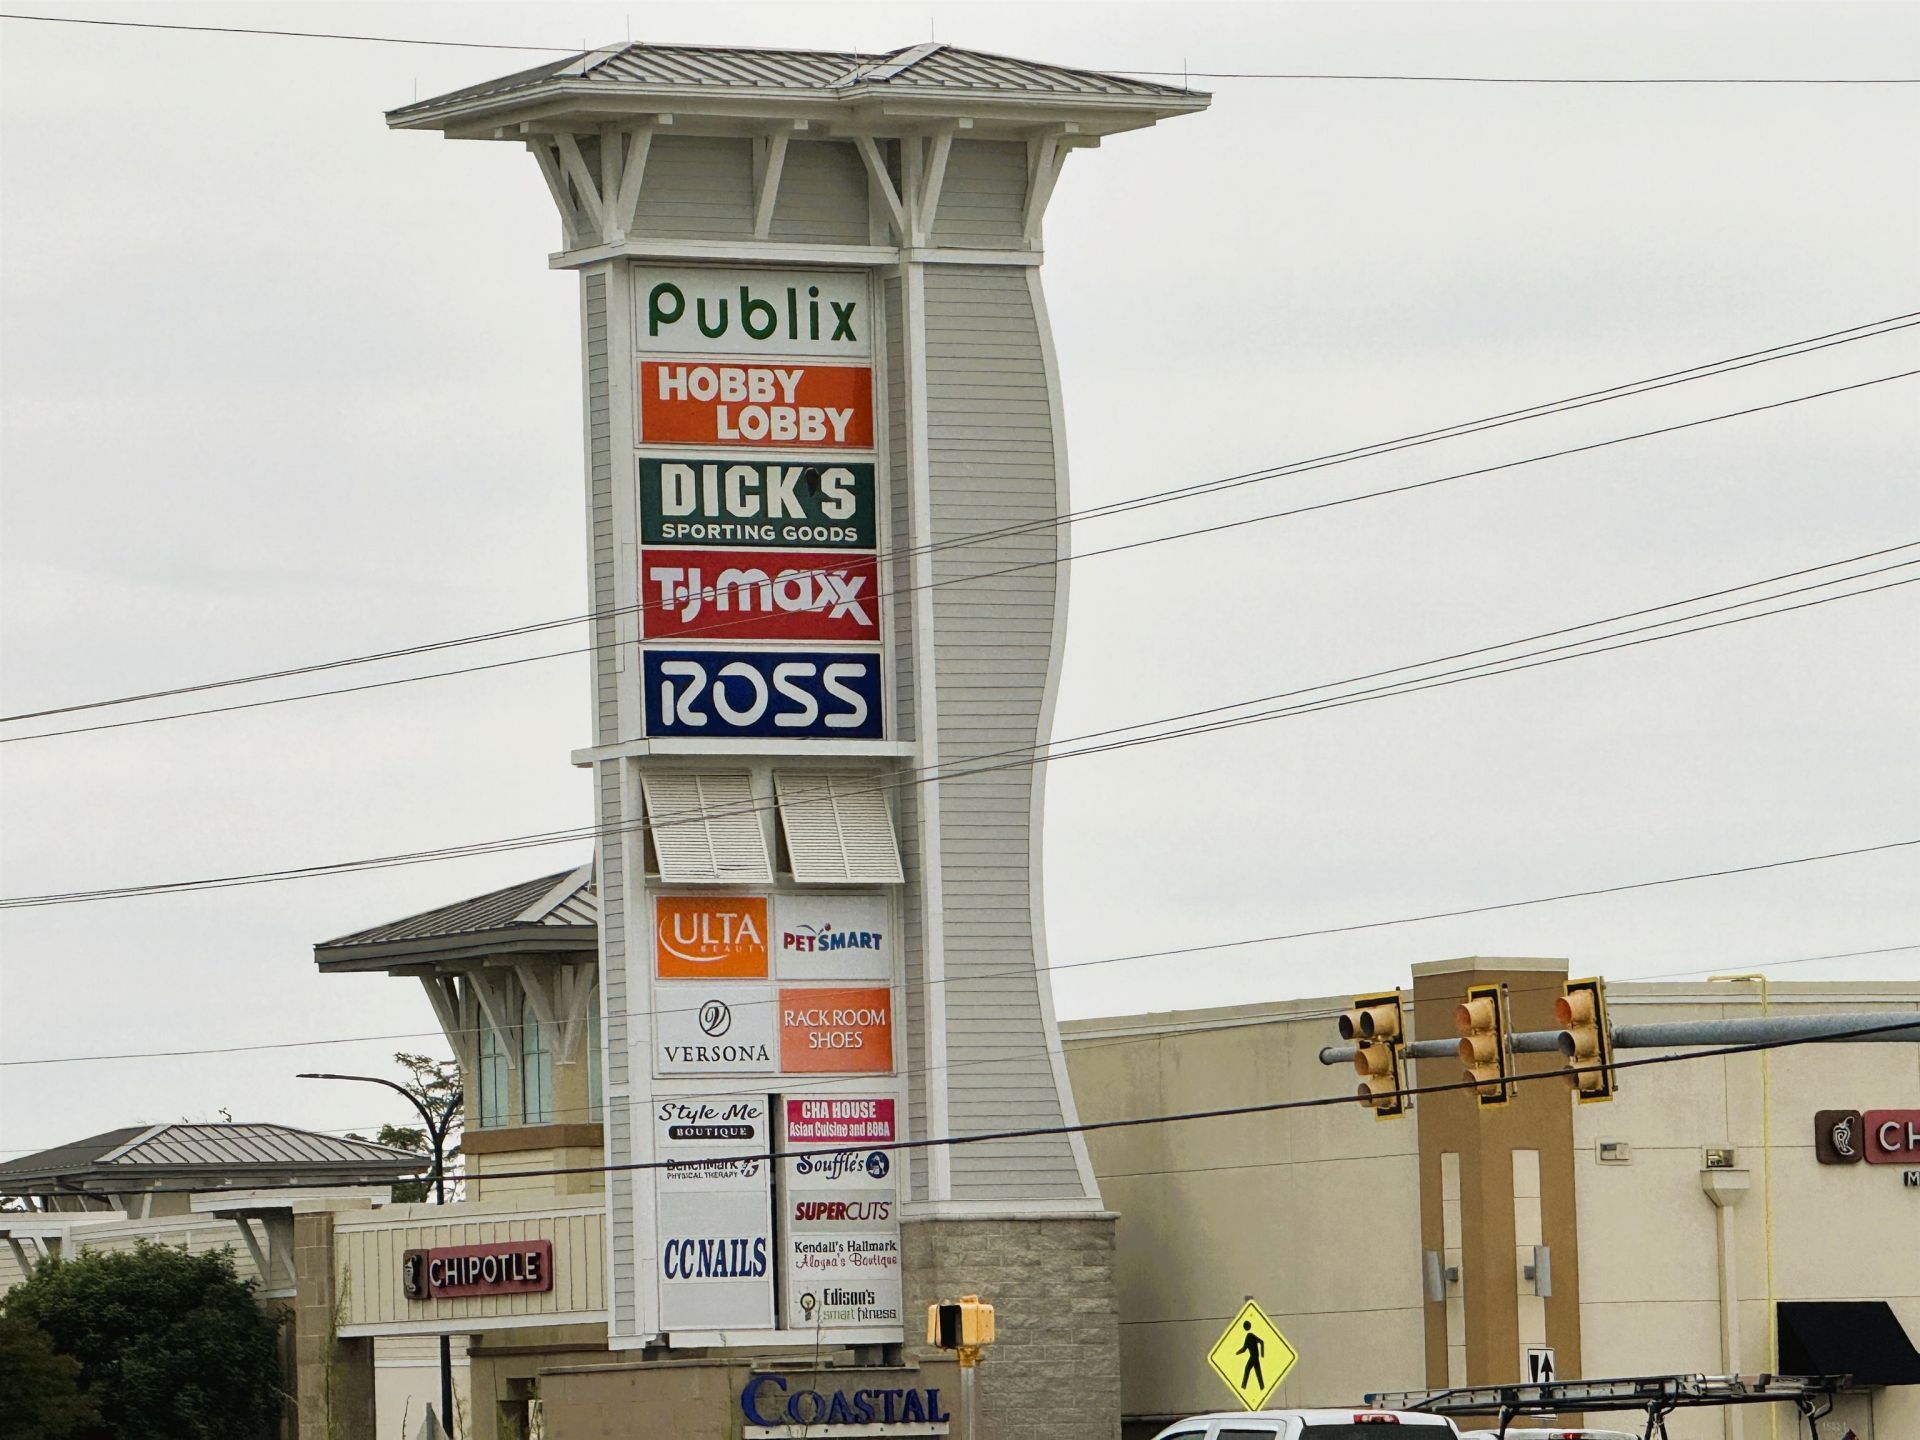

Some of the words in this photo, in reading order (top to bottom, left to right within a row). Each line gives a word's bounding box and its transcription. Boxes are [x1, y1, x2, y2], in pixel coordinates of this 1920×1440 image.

[649, 282, 857, 342] Publix
[658, 366, 804, 403] HOBBY
[716, 405, 854, 442] LOBBY
[662, 523, 776, 541] SPORTING
[782, 526, 858, 542] GOODS
[660, 661, 868, 728] ROSS
[674, 912, 761, 945] ULTA
[700, 943, 767, 953] BEAUTY
[784, 1010, 830, 1027] RACK
[832, 1009, 886, 1027] ROOM
[808, 1031, 863, 1049] SHOES
[664, 1045, 770, 1062] VERSONA
[658, 1103, 720, 1124] Style
[721, 1103, 763, 1121] Me
[801, 1101, 829, 1118] CHA
[832, 1101, 877, 1118] HOUSE
[676, 1127, 748, 1138] BOUTIQUE
[790, 1122, 813, 1137] Asian
[815, 1121, 848, 1137] Cuisine
[849, 1123, 865, 1137] and
[867, 1121, 890, 1137] BOBA
[667, 1172, 703, 1180] PHYSICAL
[704, 1171, 738, 1179] THERAPY
[795, 1202, 890, 1220] SUPERCUTS
[794, 1241, 844, 1254] Kendall's
[847, 1240, 897, 1252] Hallmark
[696, 1237, 767, 1278] NAILS
[849, 1252, 898, 1268] Boutique
[429, 1252, 538, 1287] CHIPOTLE
[823, 1287, 875, 1306] Edison's
[823, 1308, 855, 1321] smart
[741, 1374, 950, 1426] COASTAL
